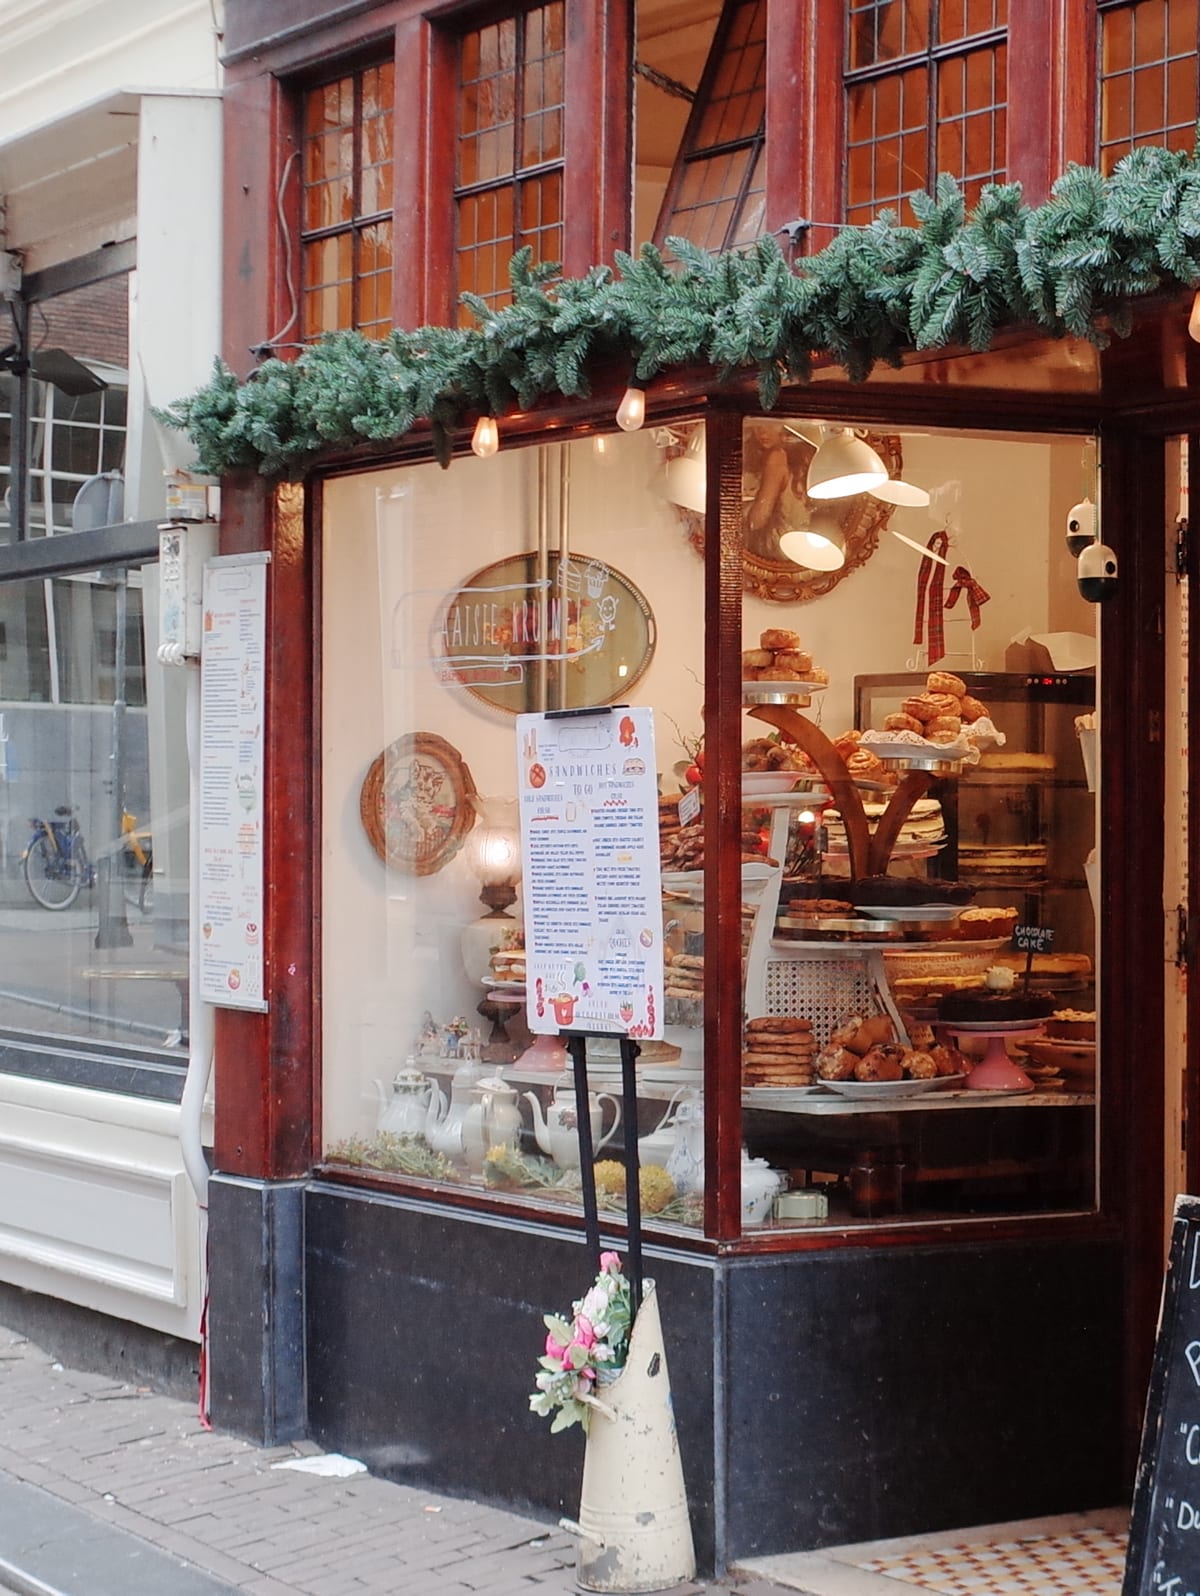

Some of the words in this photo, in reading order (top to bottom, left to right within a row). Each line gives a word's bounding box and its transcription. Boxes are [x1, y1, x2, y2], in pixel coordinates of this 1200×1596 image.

[549, 763, 617, 778] SANDWICHES
[1014, 925, 1055, 941] CHOCOLATE
[1017, 936, 1045, 951] CAKE
